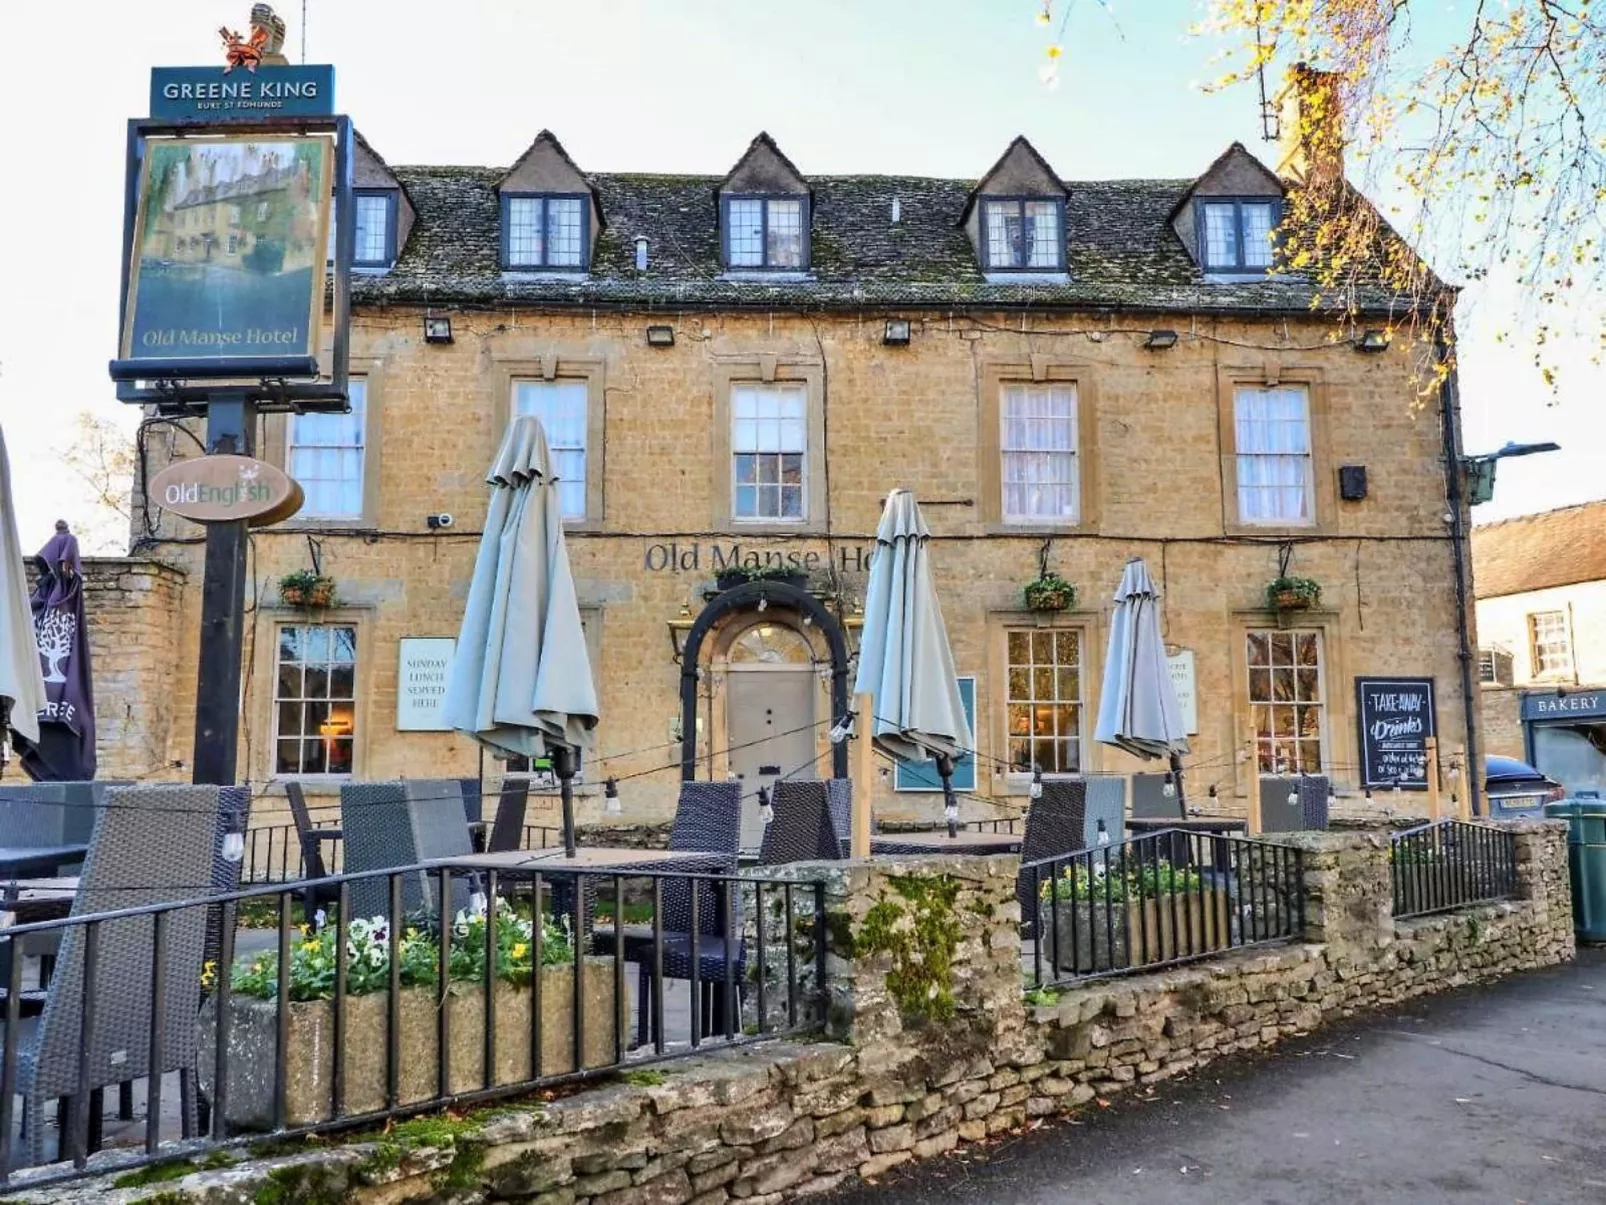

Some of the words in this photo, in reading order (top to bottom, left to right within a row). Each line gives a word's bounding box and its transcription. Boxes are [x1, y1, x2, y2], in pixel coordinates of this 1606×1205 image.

[163, 82, 251, 99] GREENE
[260, 81, 317, 98] KING
[237, 100, 282, 109] EDMUNDS
[142, 329, 174, 346] Old
[179, 329, 242, 345] Manse
[247, 327, 298, 344] Hotel
[645, 542, 699, 572] Old
[710, 544, 820, 572] Manse
[407, 659, 447, 669] SUNDAY
[409, 672, 444, 682] LUNCH
[407, 686, 446, 695] SERVED
[1538, 697, 1598, 712] BAKERY
